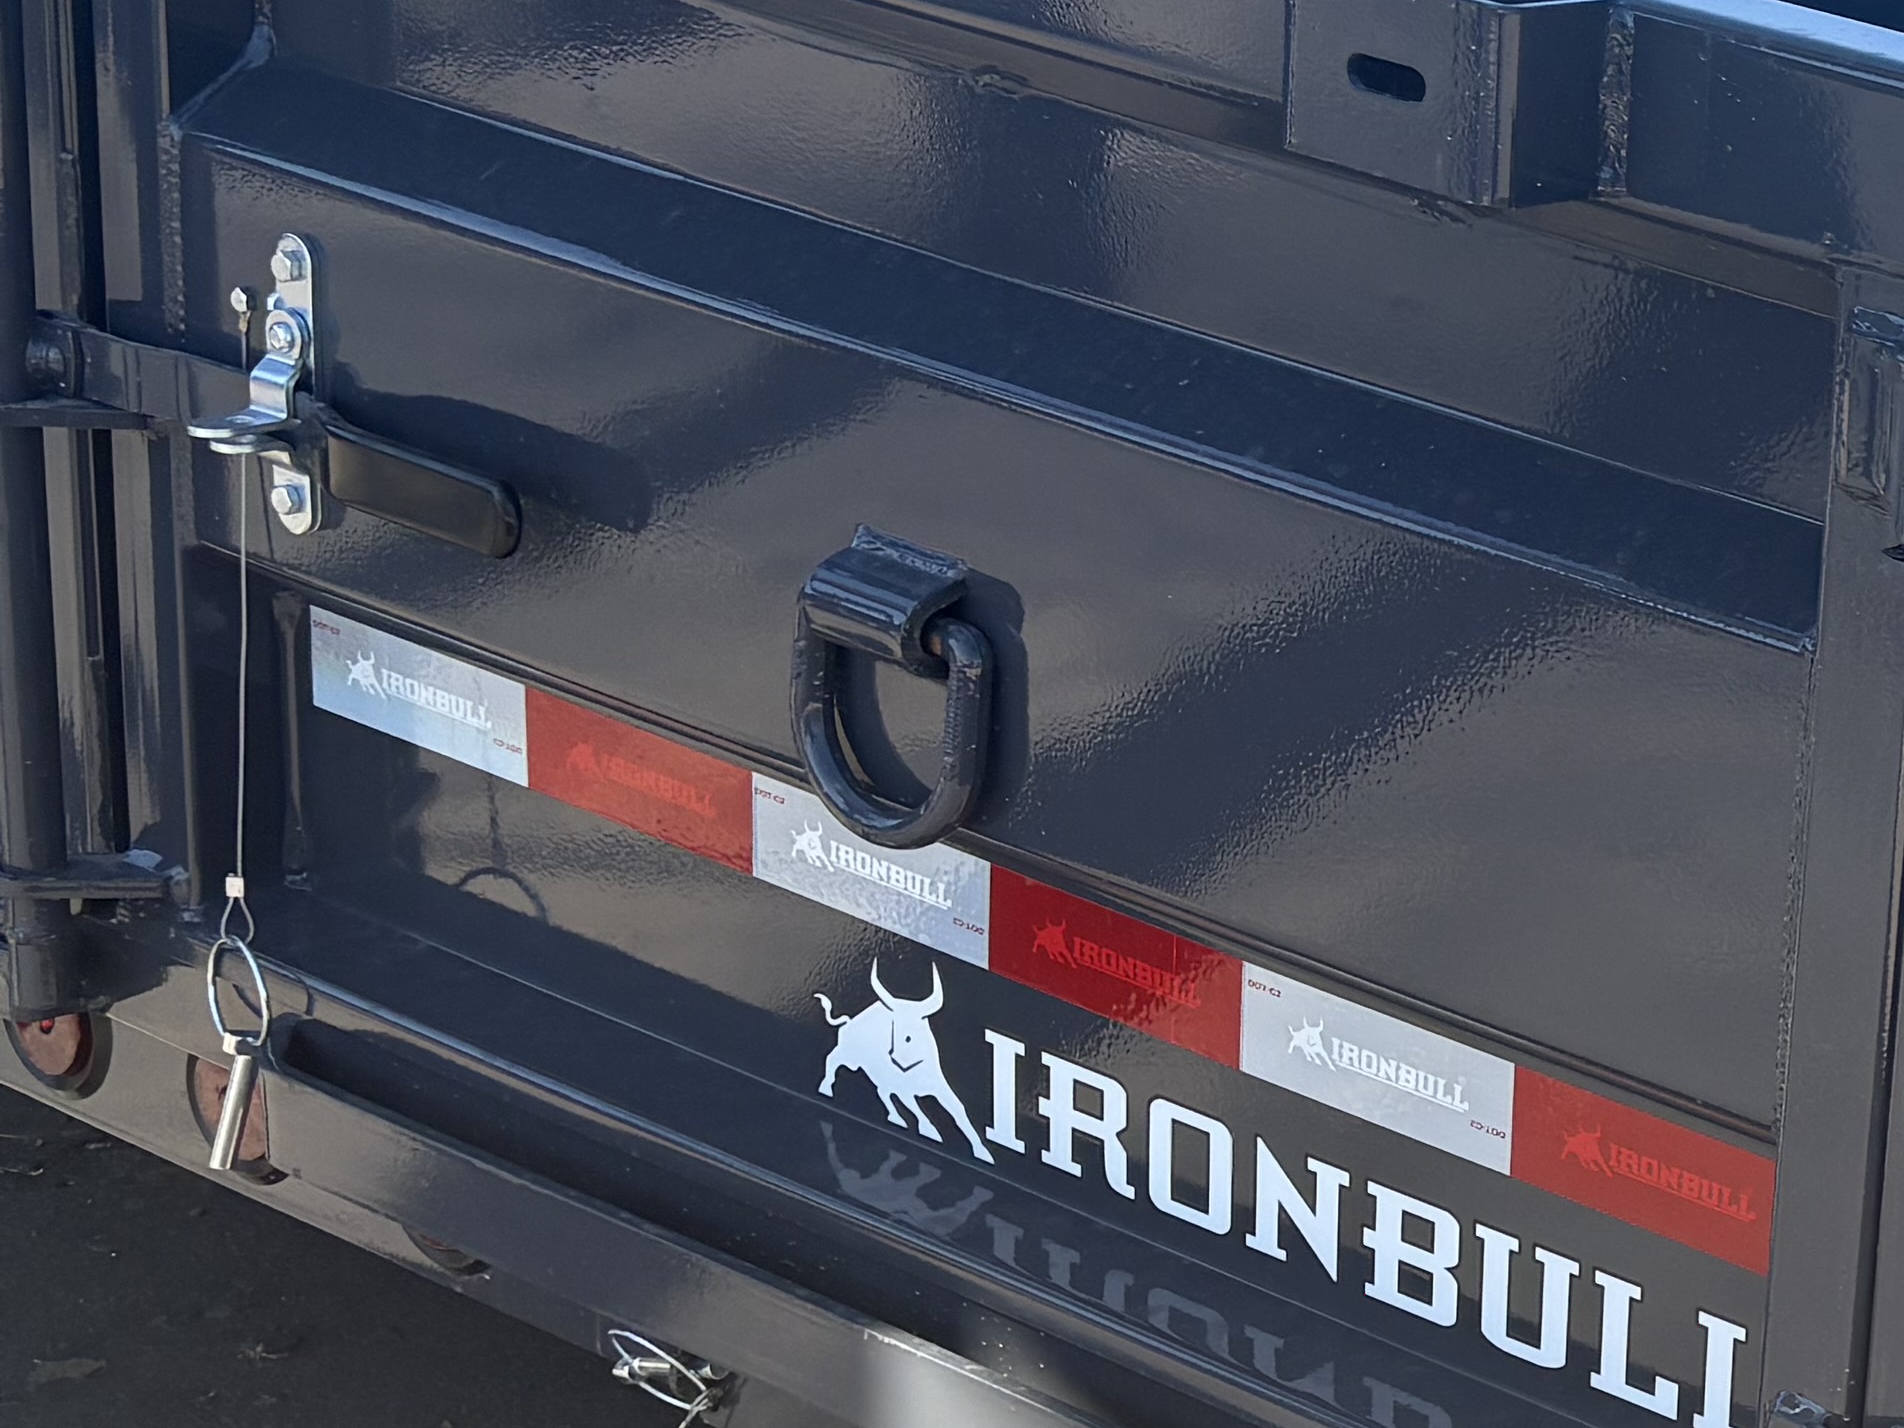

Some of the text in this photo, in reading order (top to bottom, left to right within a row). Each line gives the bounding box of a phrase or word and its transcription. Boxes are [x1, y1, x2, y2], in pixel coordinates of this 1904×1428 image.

[381, 667, 492, 730] IRONBULL
[602, 757, 717, 817] IRONBULL
[829, 840, 953, 909] IRONBULL
[1073, 937, 1201, 1009] IRONBULL
[1331, 1037, 1470, 1113] IRONBULL
[1609, 1142, 1757, 1222] IRONBULL
